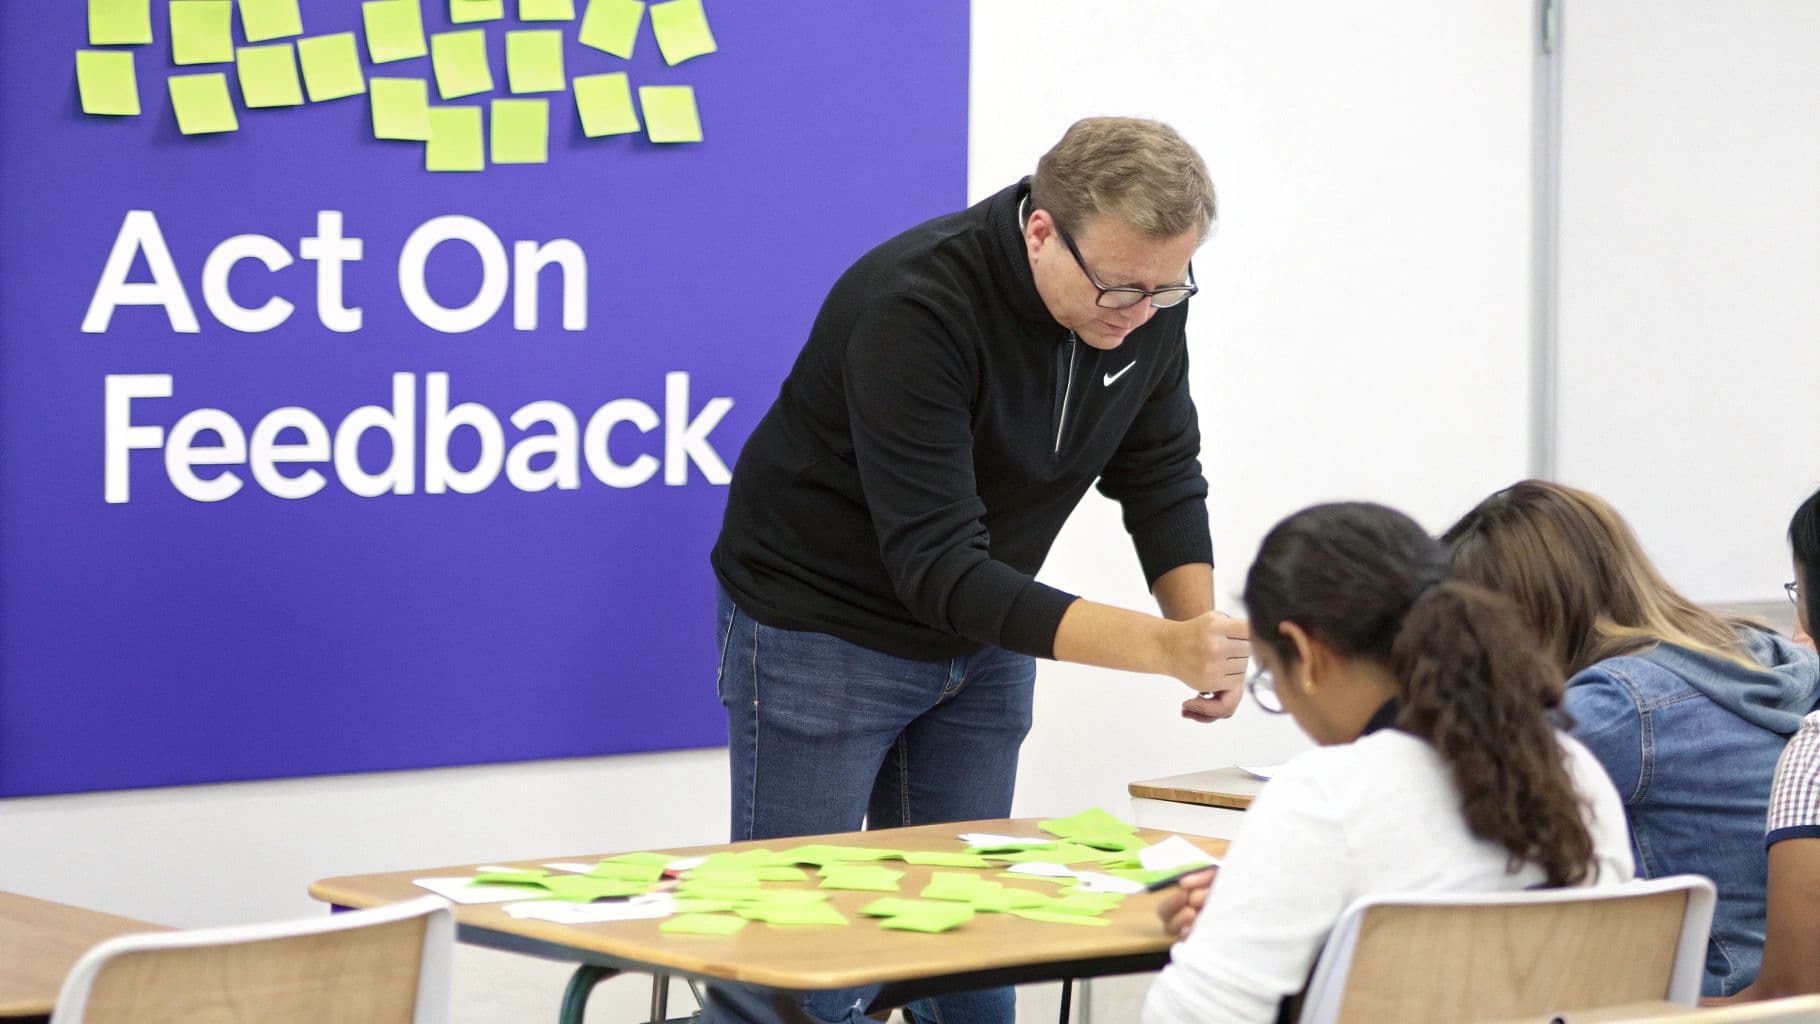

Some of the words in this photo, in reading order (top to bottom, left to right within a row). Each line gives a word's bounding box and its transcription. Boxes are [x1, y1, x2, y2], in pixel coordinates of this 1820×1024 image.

[81, 210, 363, 333] Act
[398, 214, 588, 333] On
[104, 371, 734, 503] Feedback
